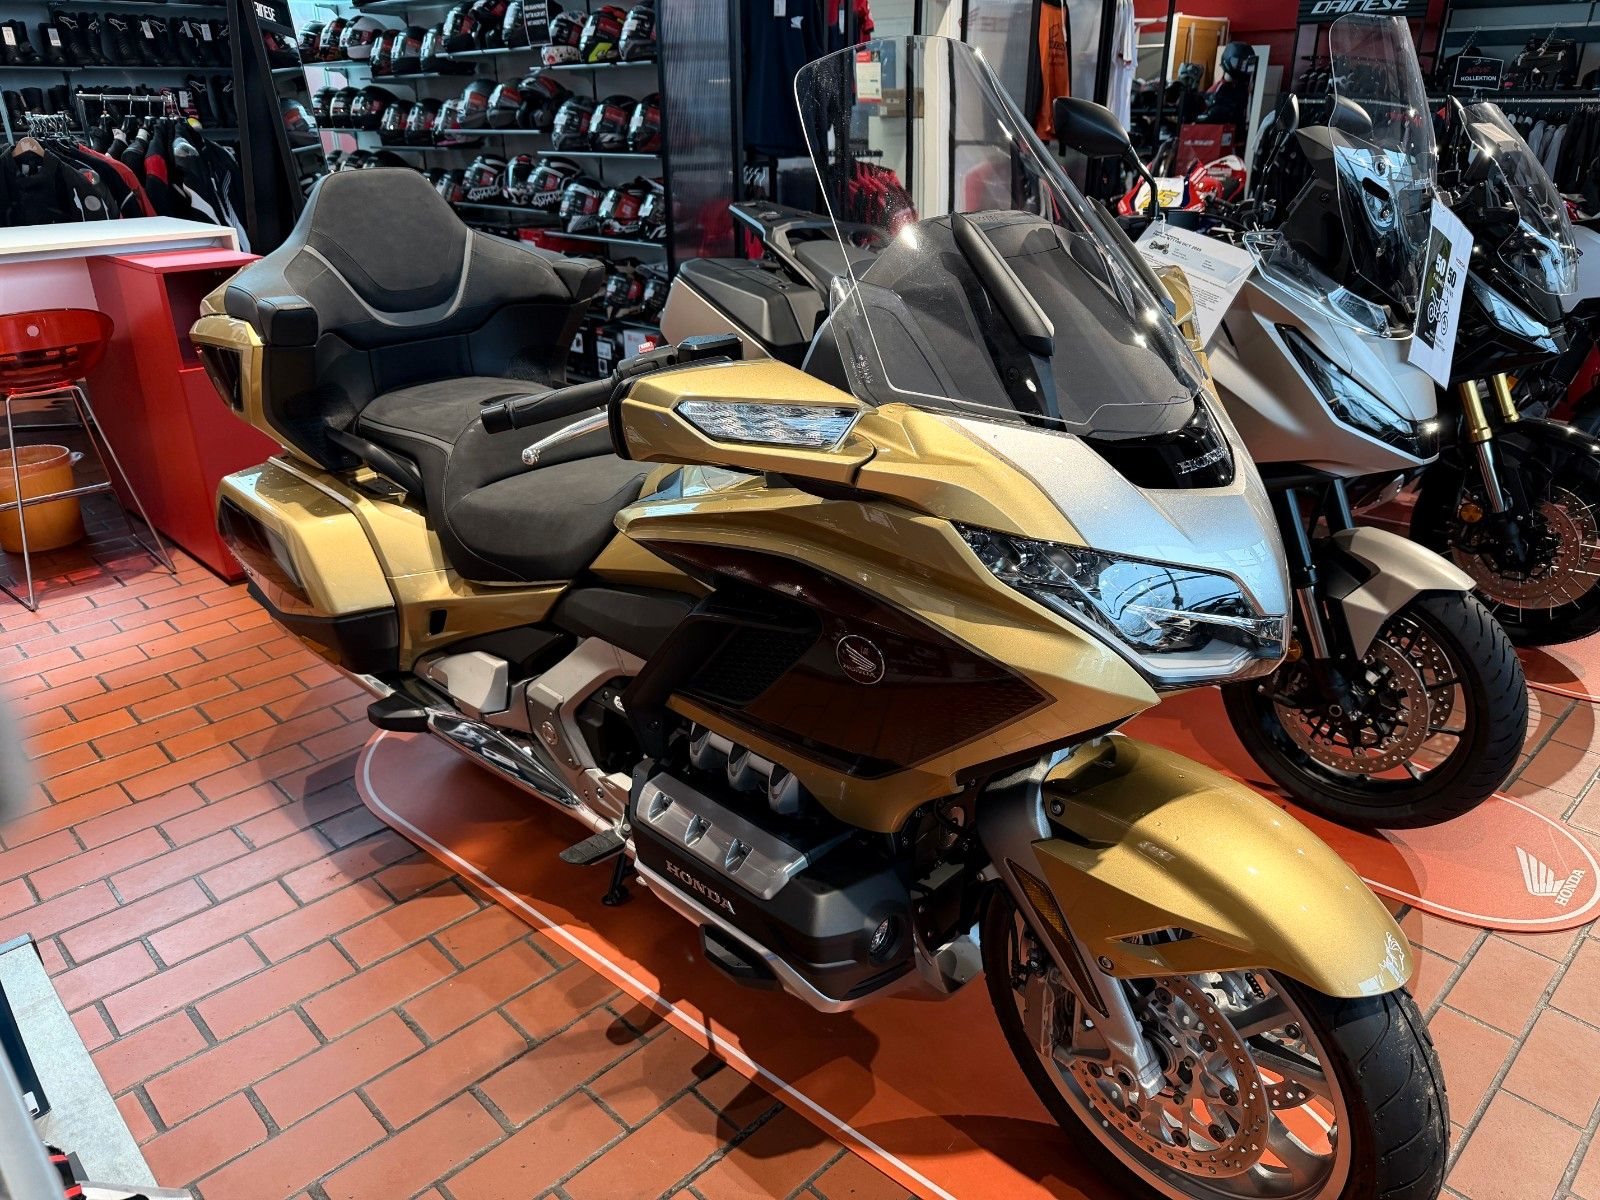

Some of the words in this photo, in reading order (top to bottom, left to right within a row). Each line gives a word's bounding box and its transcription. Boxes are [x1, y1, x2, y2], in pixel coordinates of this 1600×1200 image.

[1311, 0, 1409, 14] DAINESE
[1435, 253, 1446, 277] 50
[1447, 266, 1457, 288] 50
[665, 860, 737, 915] HONDA
[1554, 869, 1585, 906] HONDA
